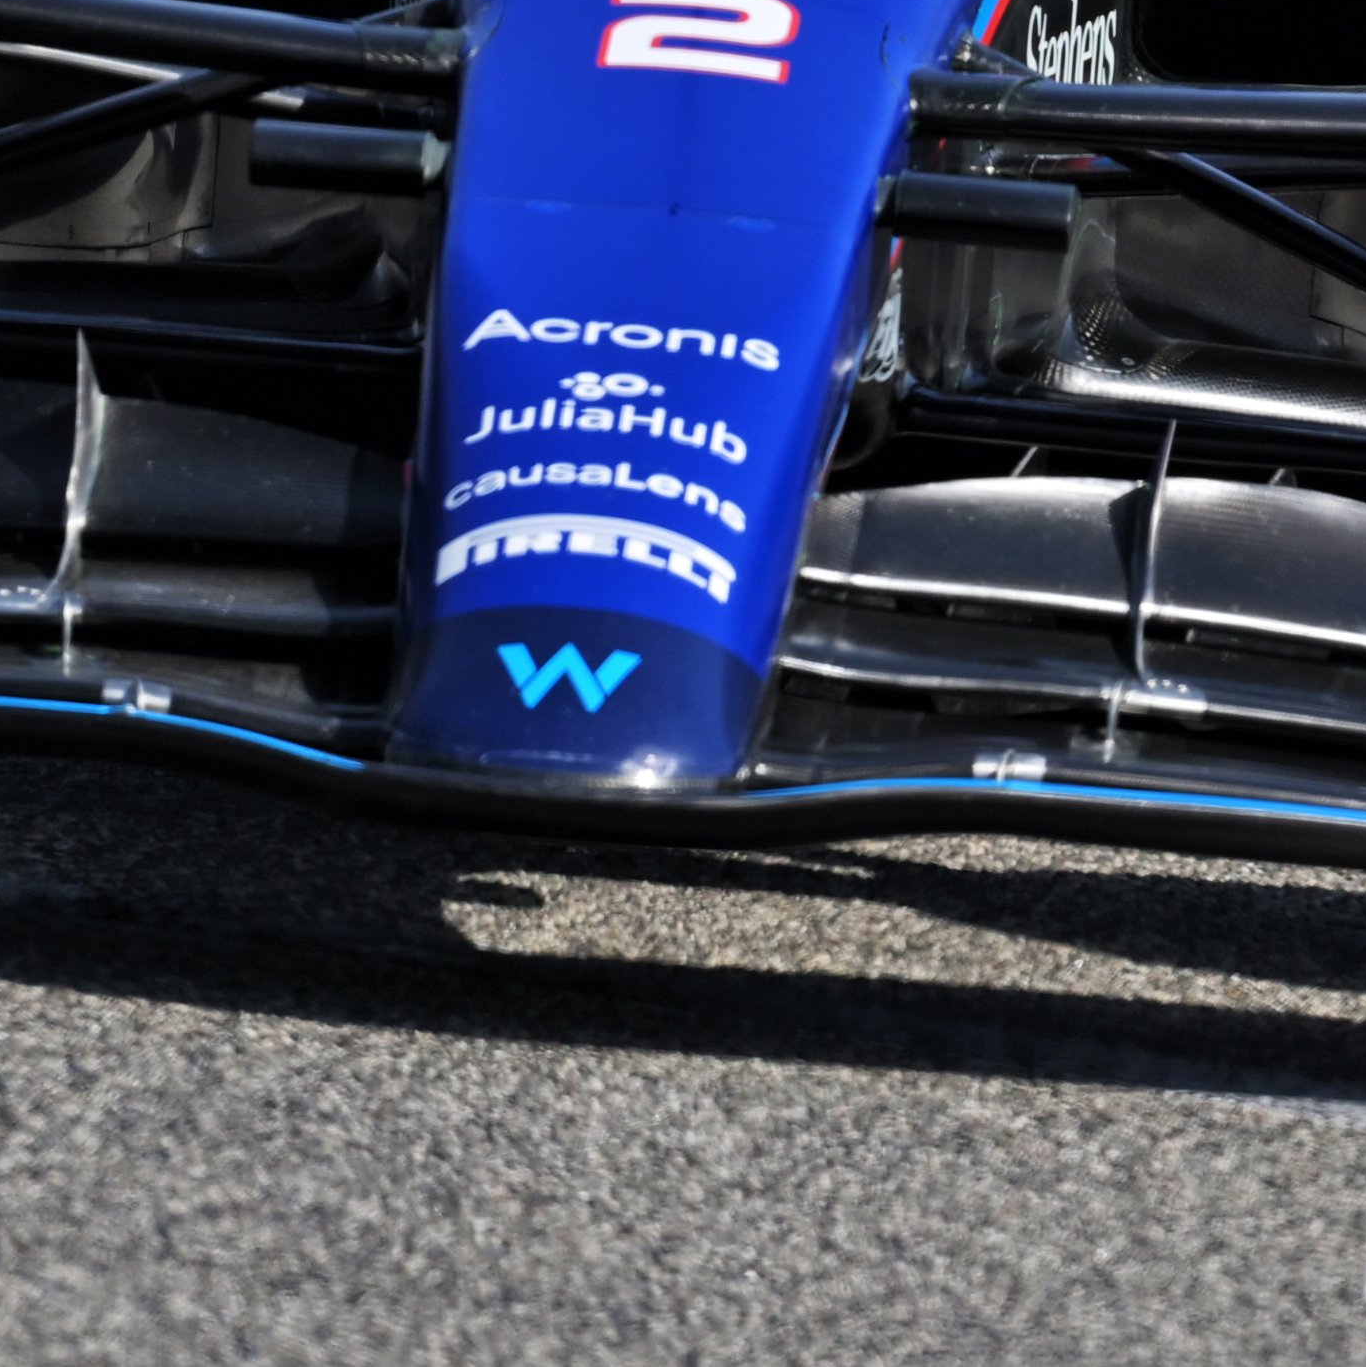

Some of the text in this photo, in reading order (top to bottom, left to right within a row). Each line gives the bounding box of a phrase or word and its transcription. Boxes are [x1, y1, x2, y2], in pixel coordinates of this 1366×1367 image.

[463, 308, 779, 372] Acronis
[464, 397, 748, 465] JuliaHub
[443, 460, 747, 534] causaLens
[435, 512, 738, 605] PIRELLI
